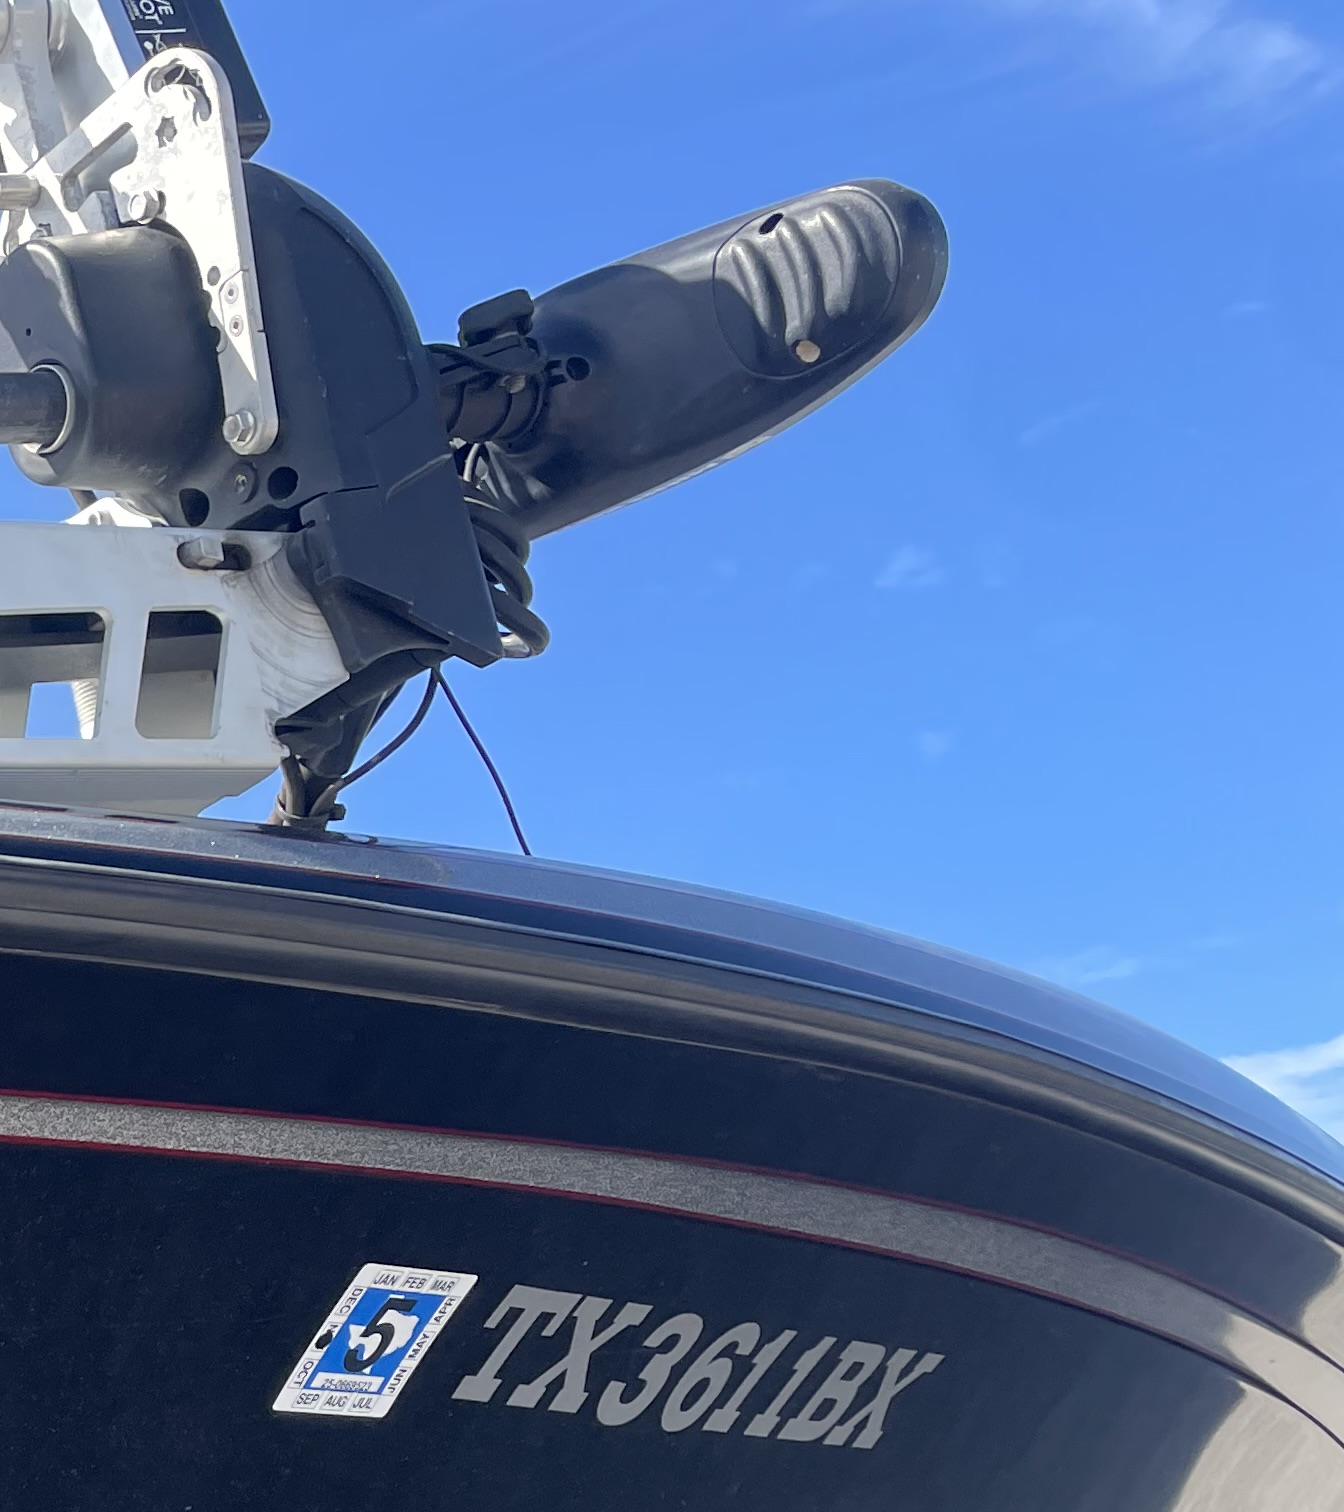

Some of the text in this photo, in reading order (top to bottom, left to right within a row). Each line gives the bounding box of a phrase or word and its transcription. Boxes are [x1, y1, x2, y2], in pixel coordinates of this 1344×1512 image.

[373, 1274, 456, 1293] JAN FEB MAR
[339, 1288, 363, 1315] DEC
[433, 1297, 456, 1323] APR
[343, 1298, 419, 1373] 5
[407, 1332, 430, 1359] MAY
[293, 1361, 314, 1387] OCT
[451, 1284, 945, 1450] TX3611BX
[387, 1368, 408, 1393] JUN
[296, 1392, 374, 1409] SEP AUG JUL
